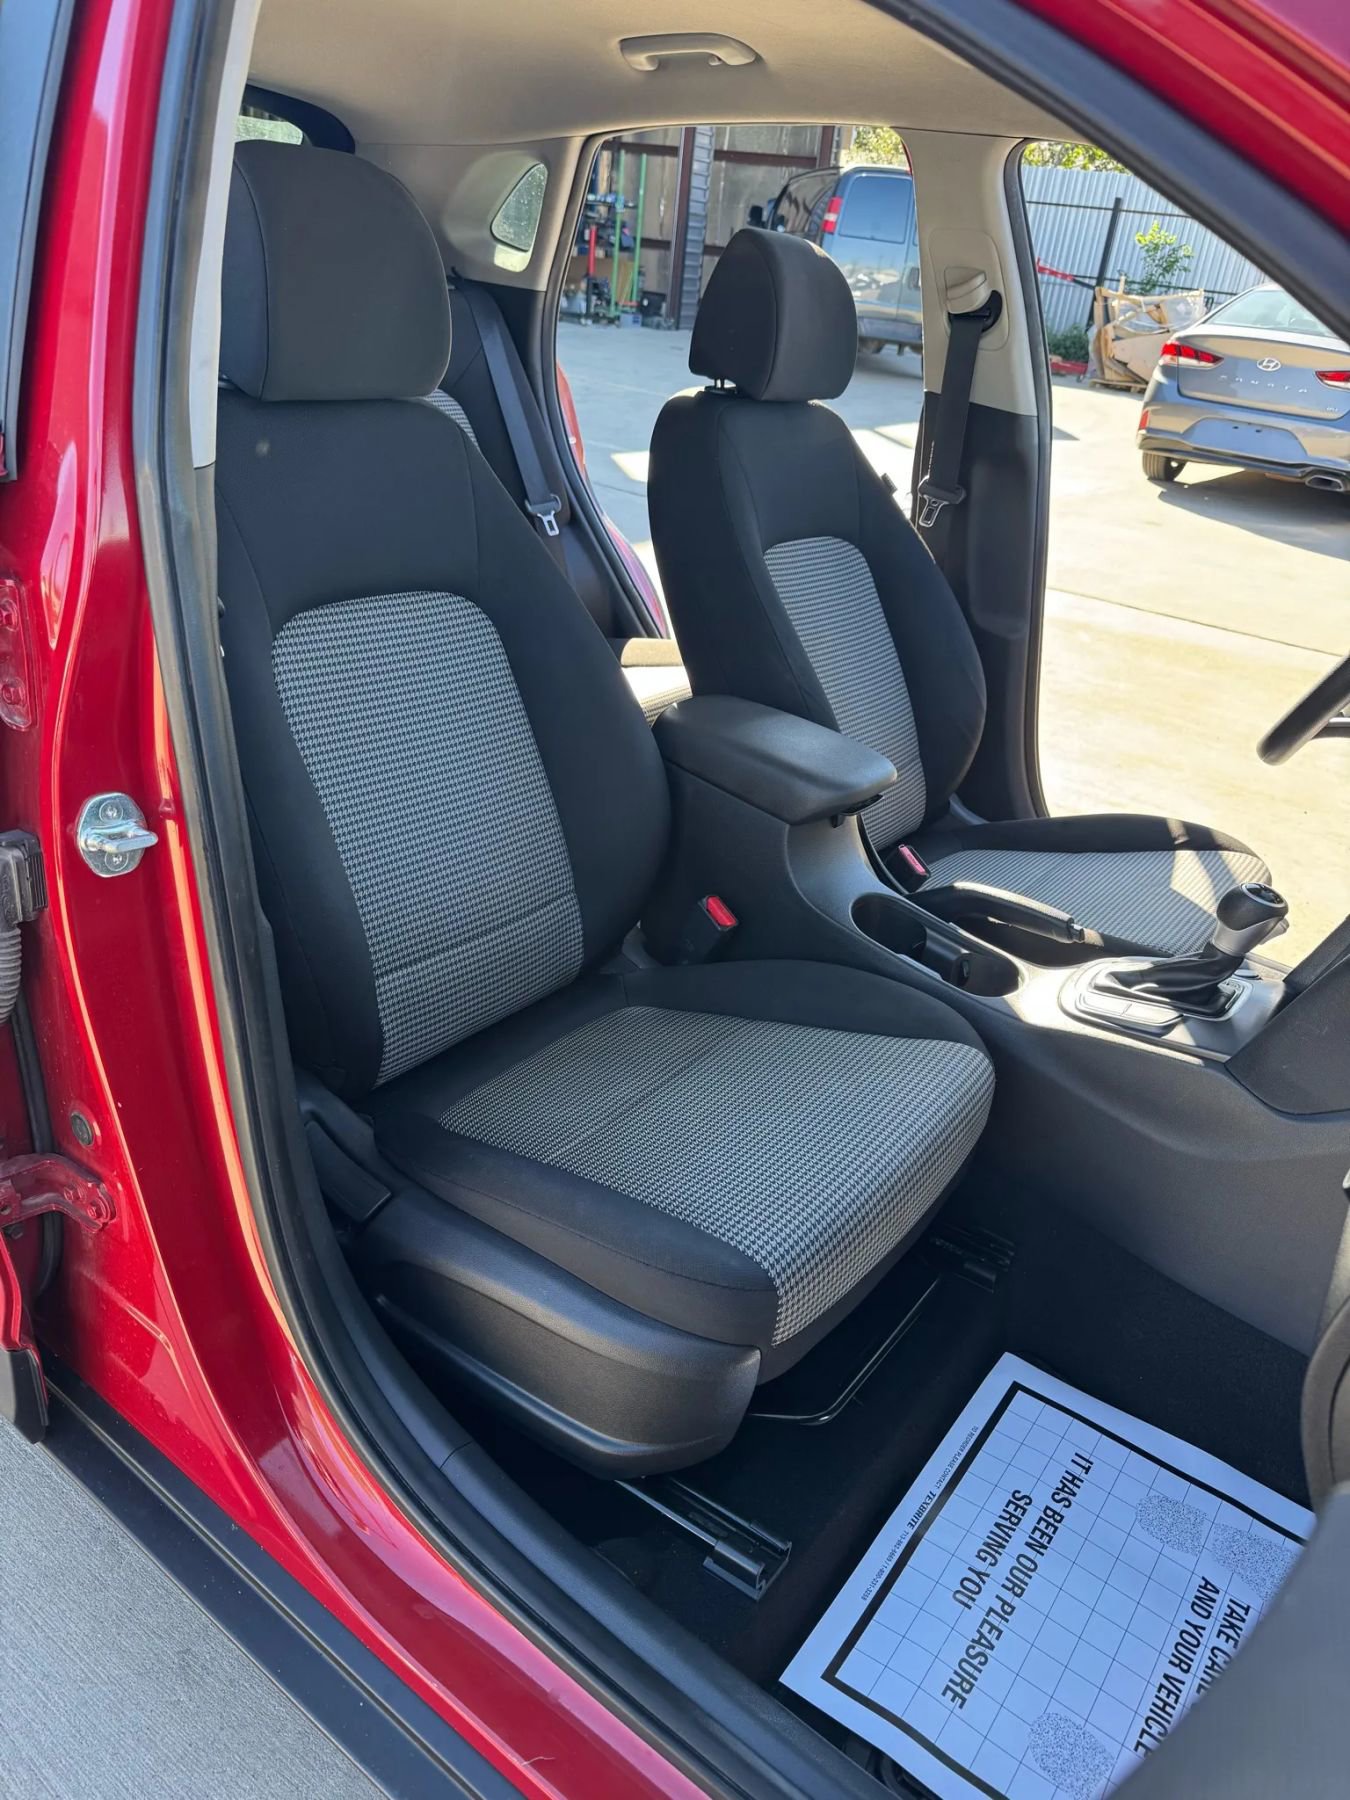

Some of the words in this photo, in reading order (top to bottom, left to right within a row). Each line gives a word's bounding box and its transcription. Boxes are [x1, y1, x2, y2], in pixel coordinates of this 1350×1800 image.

[947, 1450, 962, 1470] PLEASE
[1071, 1452, 1094, 1475] IT
[906, 1490, 937, 1530] TEXBRITE
[1050, 1469, 1084, 1509] HAS
[975, 1489, 1033, 1567] SERVING
[1024, 1504, 1065, 1557] BEEN
[951, 1566, 991, 1610] YOU
[1001, 1553, 1039, 1599] OUR
[1190, 1576, 1220, 1620] AND
[1168, 1619, 1206, 1674] YOUR
[1216, 1598, 1251, 1649] TAKE
[941, 1594, 1017, 1710] PLEASURE
[1133, 1672, 1186, 1756] VEHICLE
